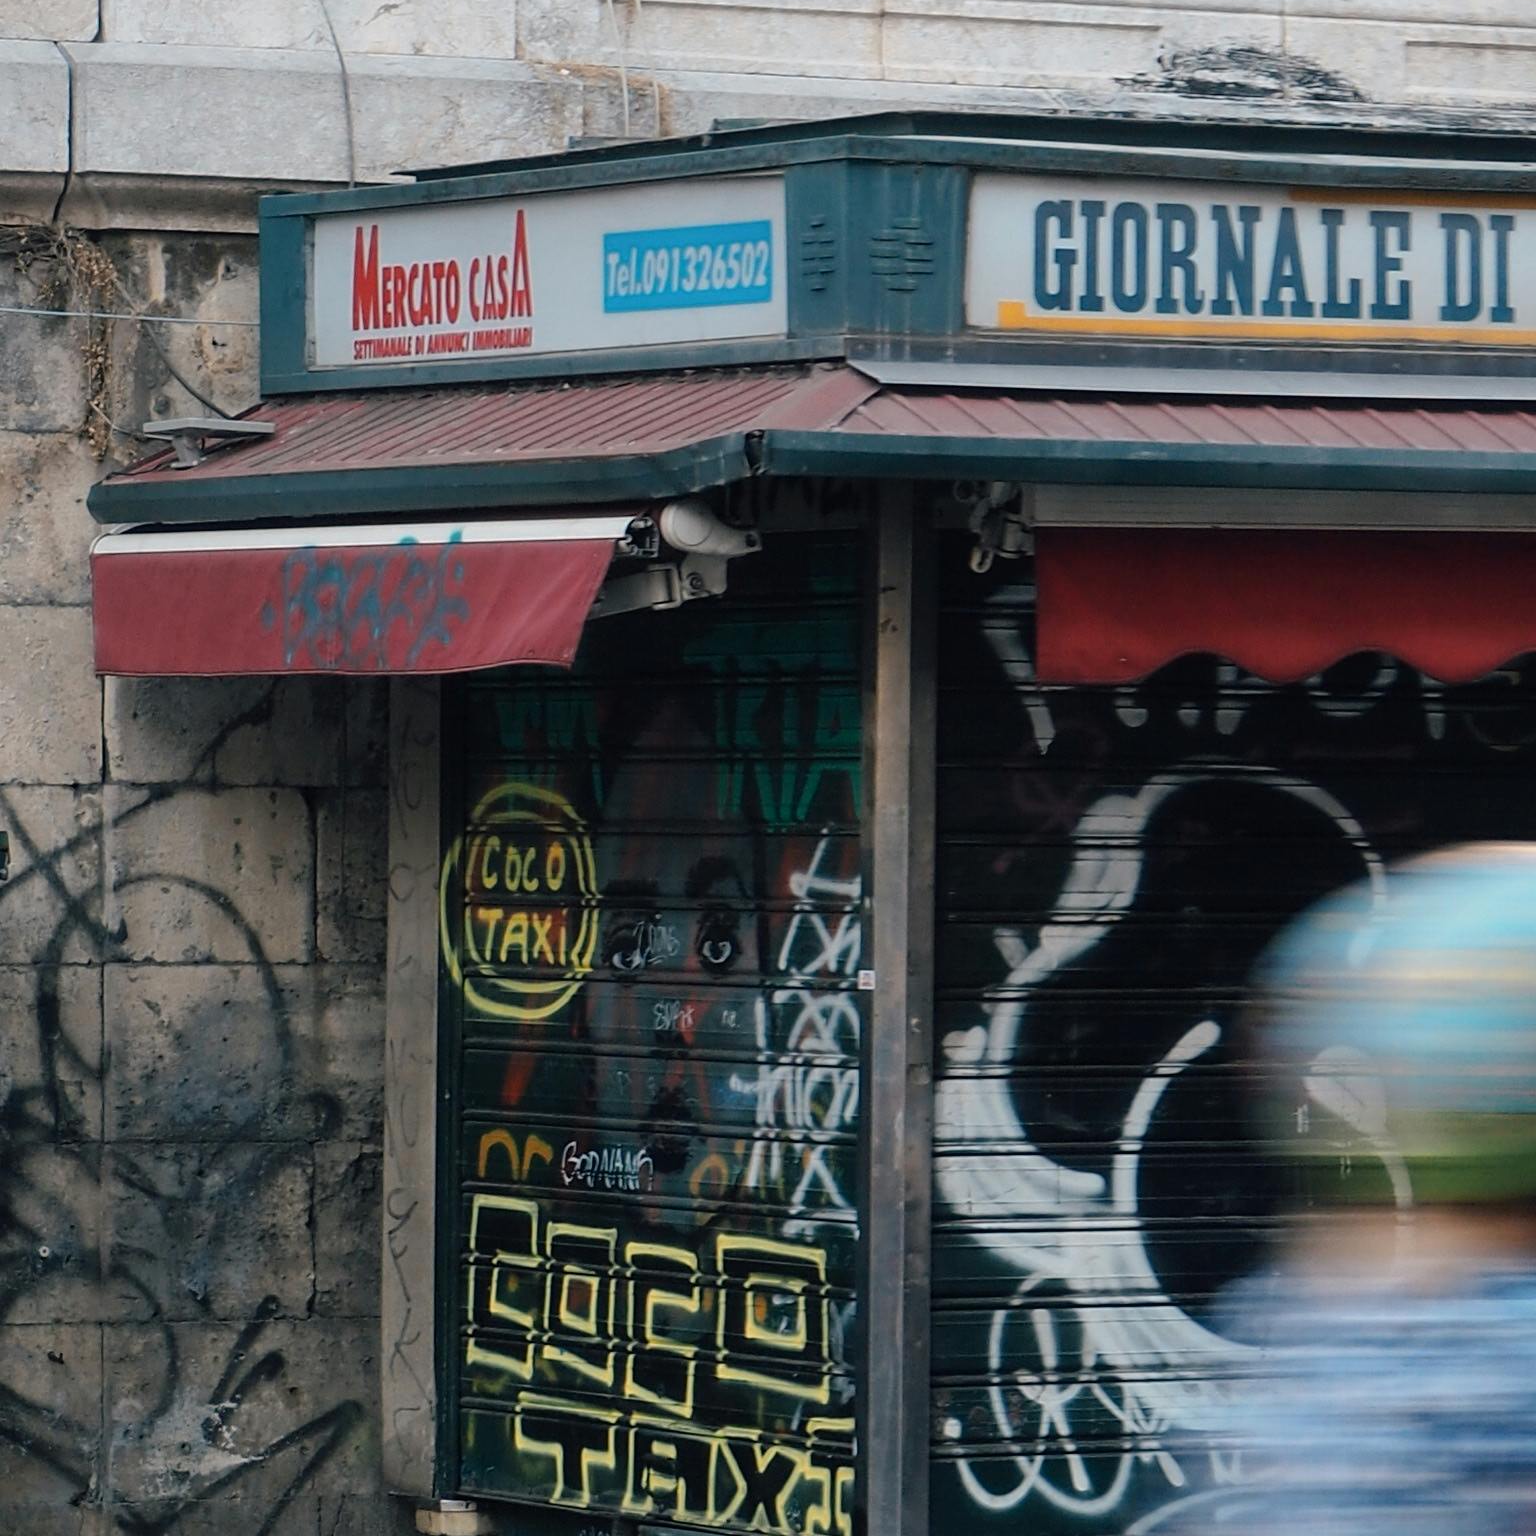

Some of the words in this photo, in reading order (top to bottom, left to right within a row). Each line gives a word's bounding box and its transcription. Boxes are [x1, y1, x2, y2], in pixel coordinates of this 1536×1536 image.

[1034, 199, 1412, 321] GIORNALE
[1439, 212, 1517, 323] DI
[353, 337, 412, 360] SETTIMANALE
[414, 335, 425, 355] DI
[427, 332, 470, 354] ANNUNCI
[472, 327, 533, 351] IMMOBILIARI
[482, 834, 566, 892] COCO
